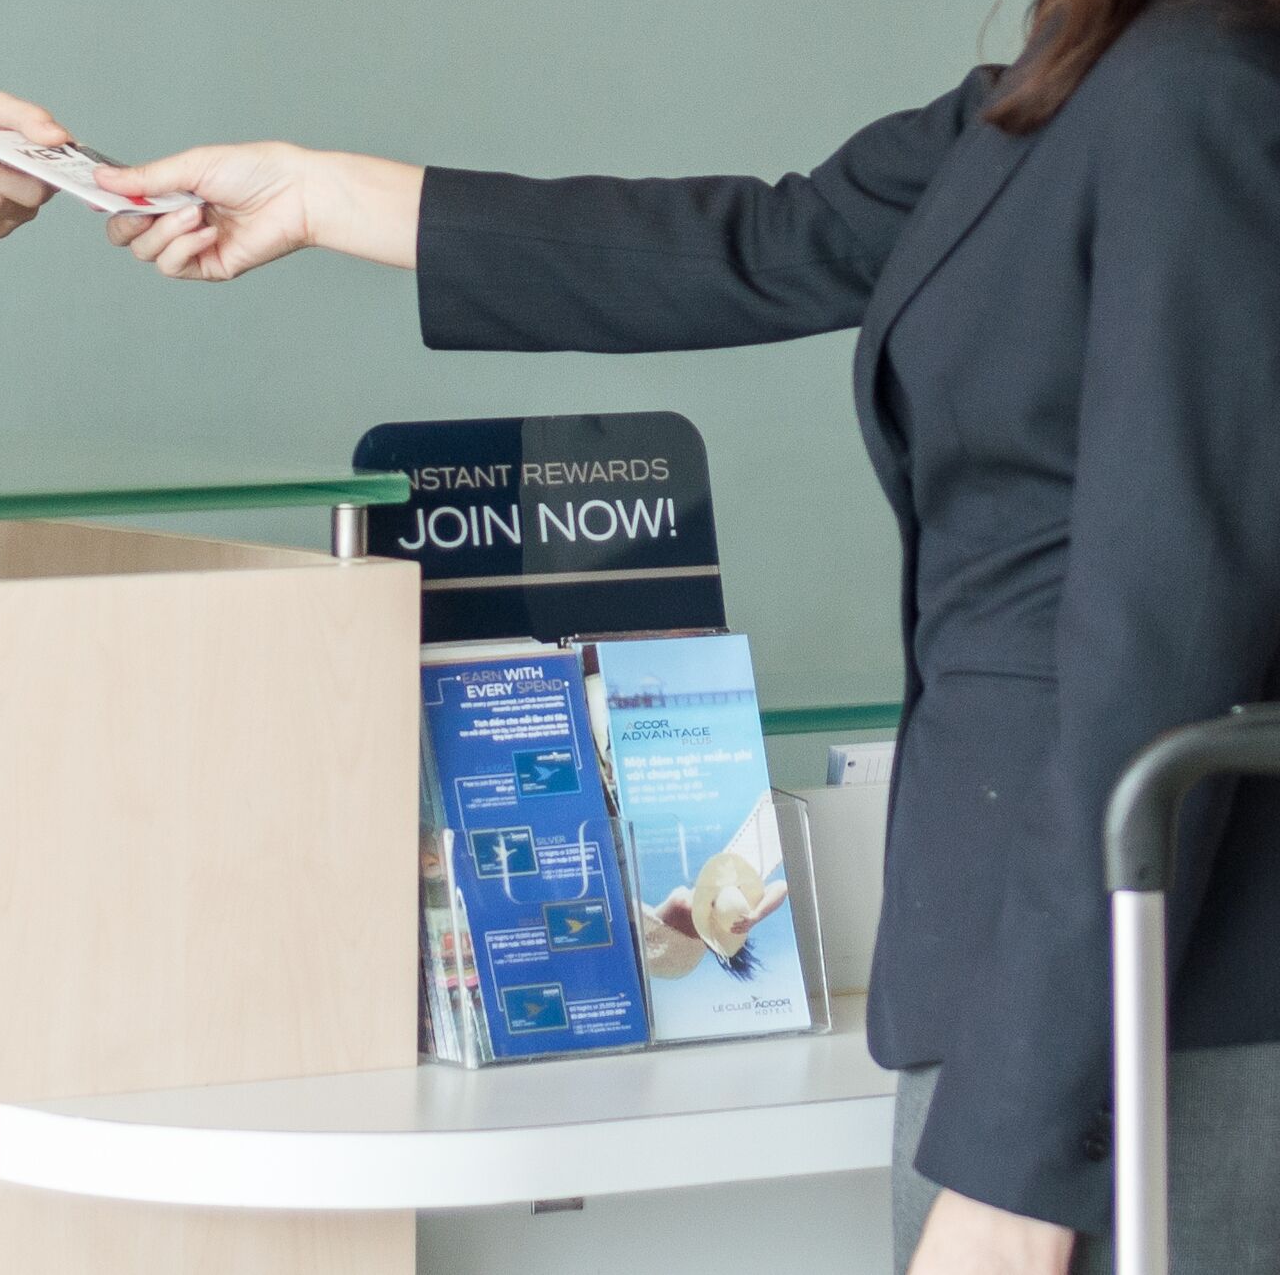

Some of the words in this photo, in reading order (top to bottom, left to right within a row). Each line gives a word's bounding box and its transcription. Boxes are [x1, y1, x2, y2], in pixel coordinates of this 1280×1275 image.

[15, 146, 74, 161] KEY
[402, 465, 512, 490] NSTANT
[521, 458, 669, 486] REWARDS
[398, 503, 521, 550] JOIN
[538, 498, 677, 543] NOW!
[461, 670, 502, 684] EARN
[503, 666, 543, 681] WITH
[466, 682, 513, 699] EVERY
[516, 679, 562, 694] SPEND
[625, 719, 669, 731] ACCOR
[622, 726, 711, 742] ADVANTAGE
[755, 998, 792, 1009] ACCOR
